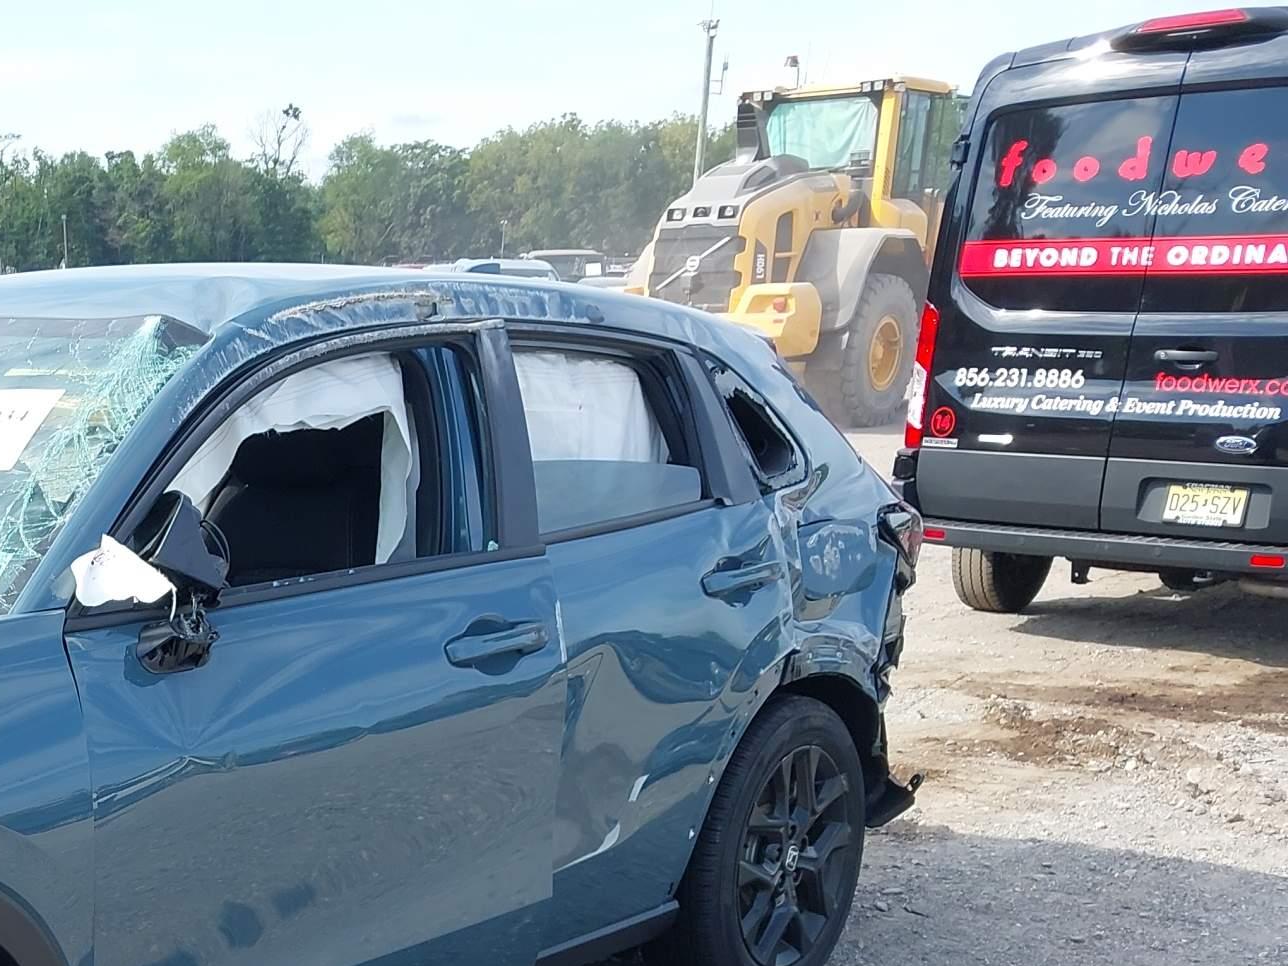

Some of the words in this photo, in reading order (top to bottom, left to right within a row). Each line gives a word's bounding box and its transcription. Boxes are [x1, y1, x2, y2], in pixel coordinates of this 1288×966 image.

[1021, 193, 1118, 227] Featuring
[1122, 190, 1218, 217] Nicholas
[993, 248, 1098, 268] BEYOND
[1110, 247, 1155, 266] THE
[1166, 244, 1288, 266] ORDINA
[954, 368, 1086, 388] 856.231.8886
[970, 393, 1030, 412] Luxury
[1031, 394, 1104, 415] Catering
[1105, 396, 1121, 412] &
[1122, 398, 1176, 414] Event
[1176, 400, 1281, 419] Production
